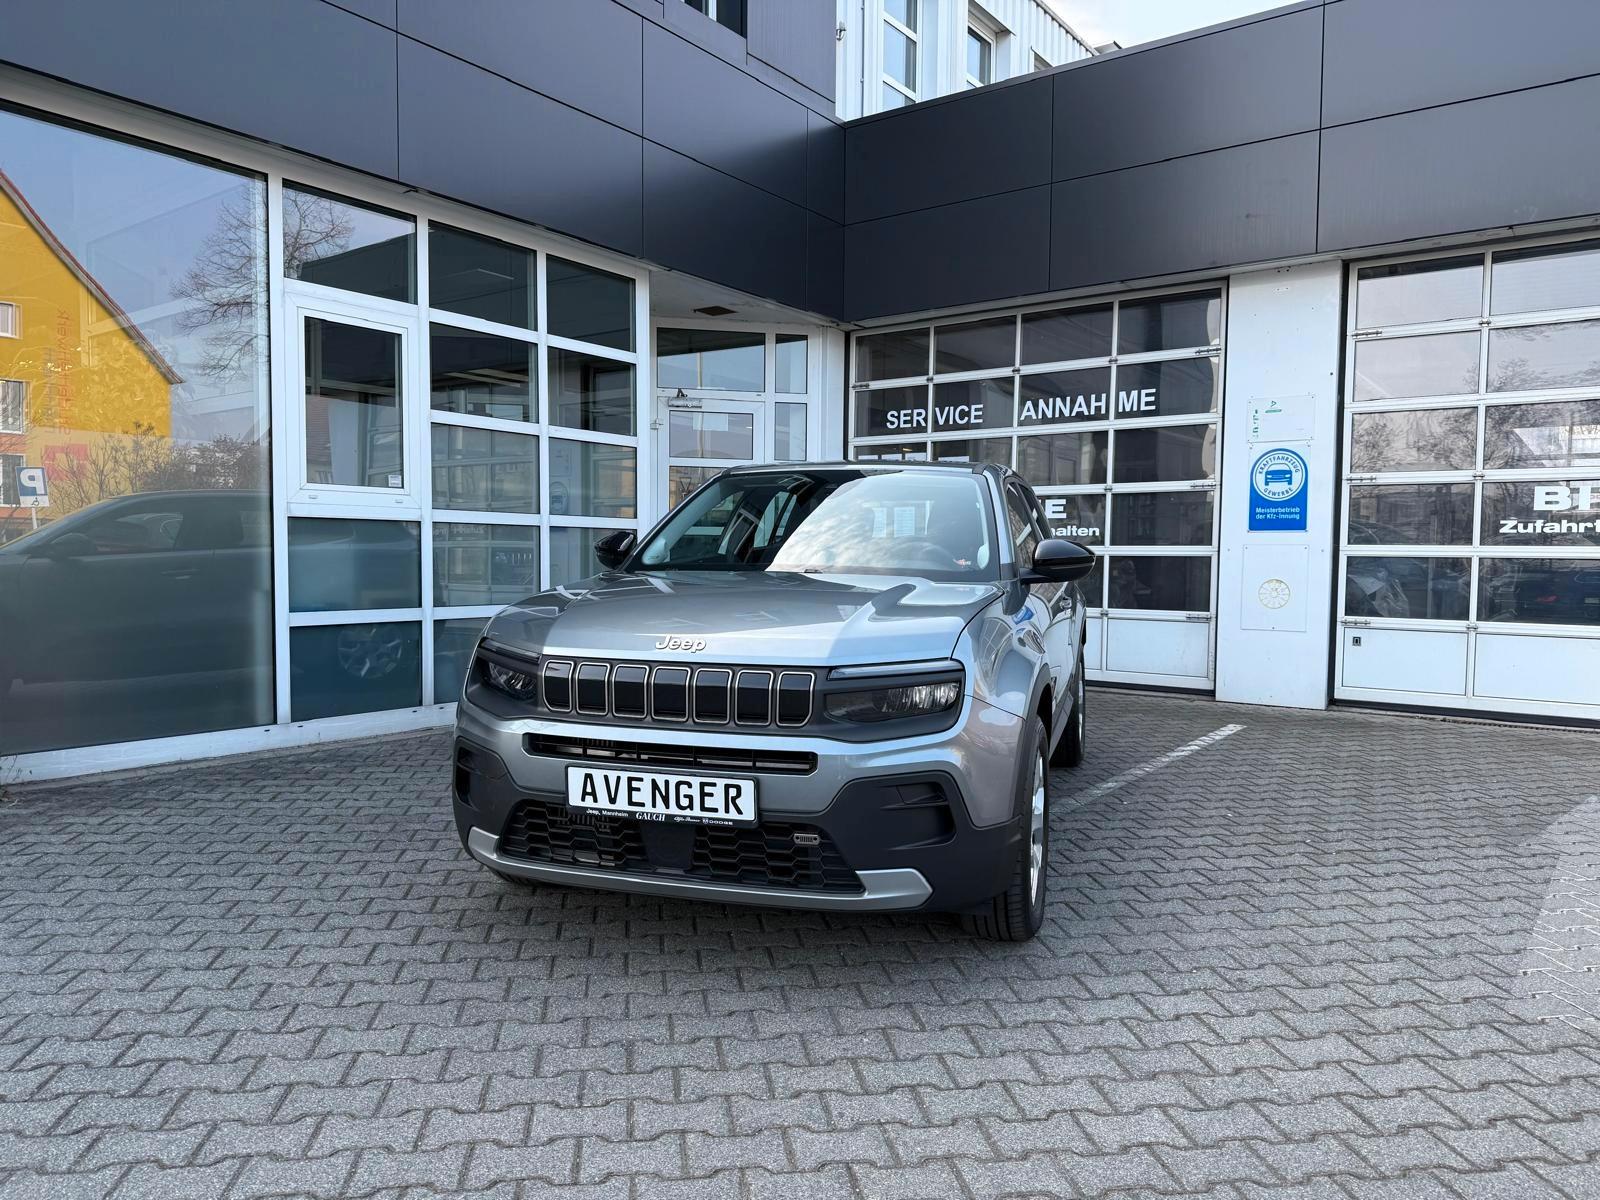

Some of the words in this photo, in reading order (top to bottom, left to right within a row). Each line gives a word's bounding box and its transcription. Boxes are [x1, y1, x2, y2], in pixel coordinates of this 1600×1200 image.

[886, 404, 984, 429] SERVICE
[1020, 388, 1156, 421] ANNAHME
[1263, 487, 1294, 497] GEWERBE
[1039, 499, 1067, 518] E
[655, 634, 707, 653] Jeep
[581, 772, 744, 816] AVENGER
